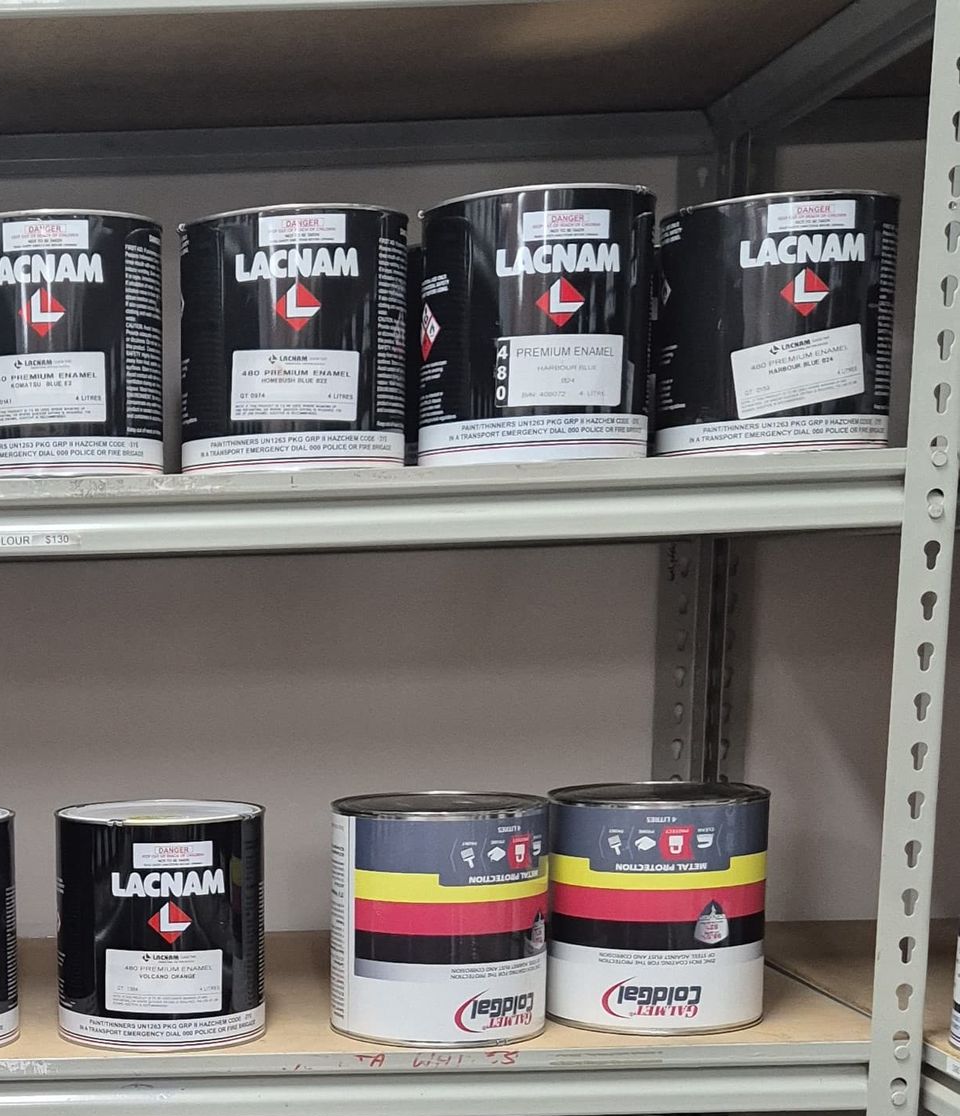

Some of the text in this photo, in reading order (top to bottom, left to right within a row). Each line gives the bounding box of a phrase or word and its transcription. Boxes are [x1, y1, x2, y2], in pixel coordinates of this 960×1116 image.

[740, 233, 865, 268] LACNAM
[235, 248, 359, 282] LACNAM
[496, 243, 620, 277] LACNAM
[517, 347, 614, 357] PREMIUM ENAMEL
[45, 535, 69, 544] $130
[616, 863, 679, 871] PROTECTION
[112, 869, 225, 897] LACNAM
[469, 870, 517, 884] PROTECTION
[617, 985, 701, 1005] ColdGal
[636, 1005, 698, 1018] GALMET
